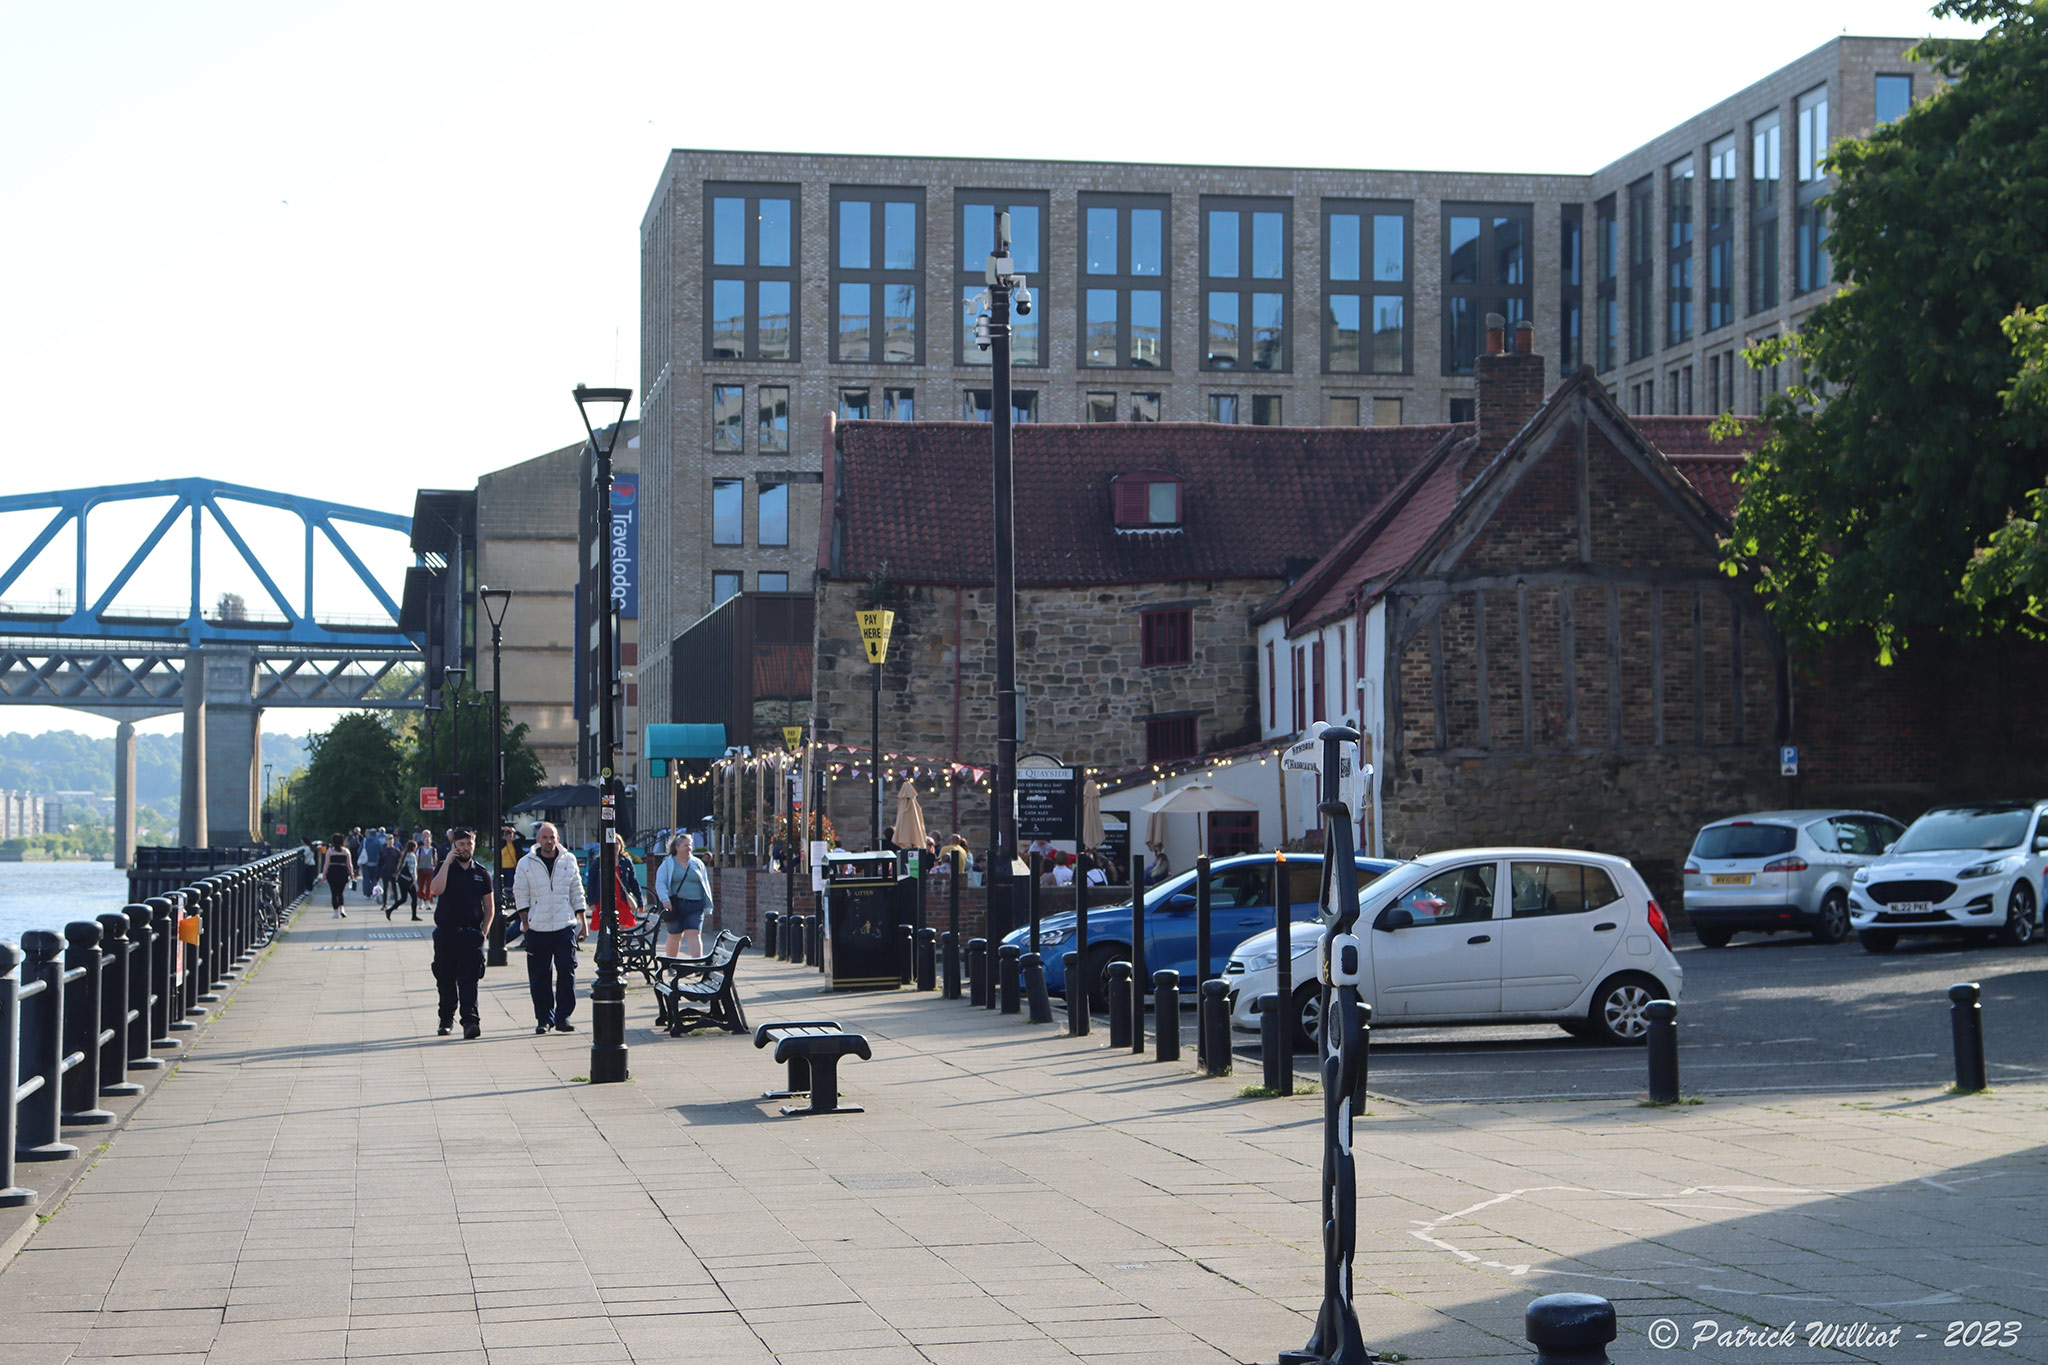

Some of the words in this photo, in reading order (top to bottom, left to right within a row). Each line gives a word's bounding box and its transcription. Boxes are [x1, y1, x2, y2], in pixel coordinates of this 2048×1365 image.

[864, 614, 877, 625] PAY
[864, 628, 881, 639] HERE
[1784, 748, 1795, 763] P
[1026, 768, 1071, 779] QUAYSIDE
